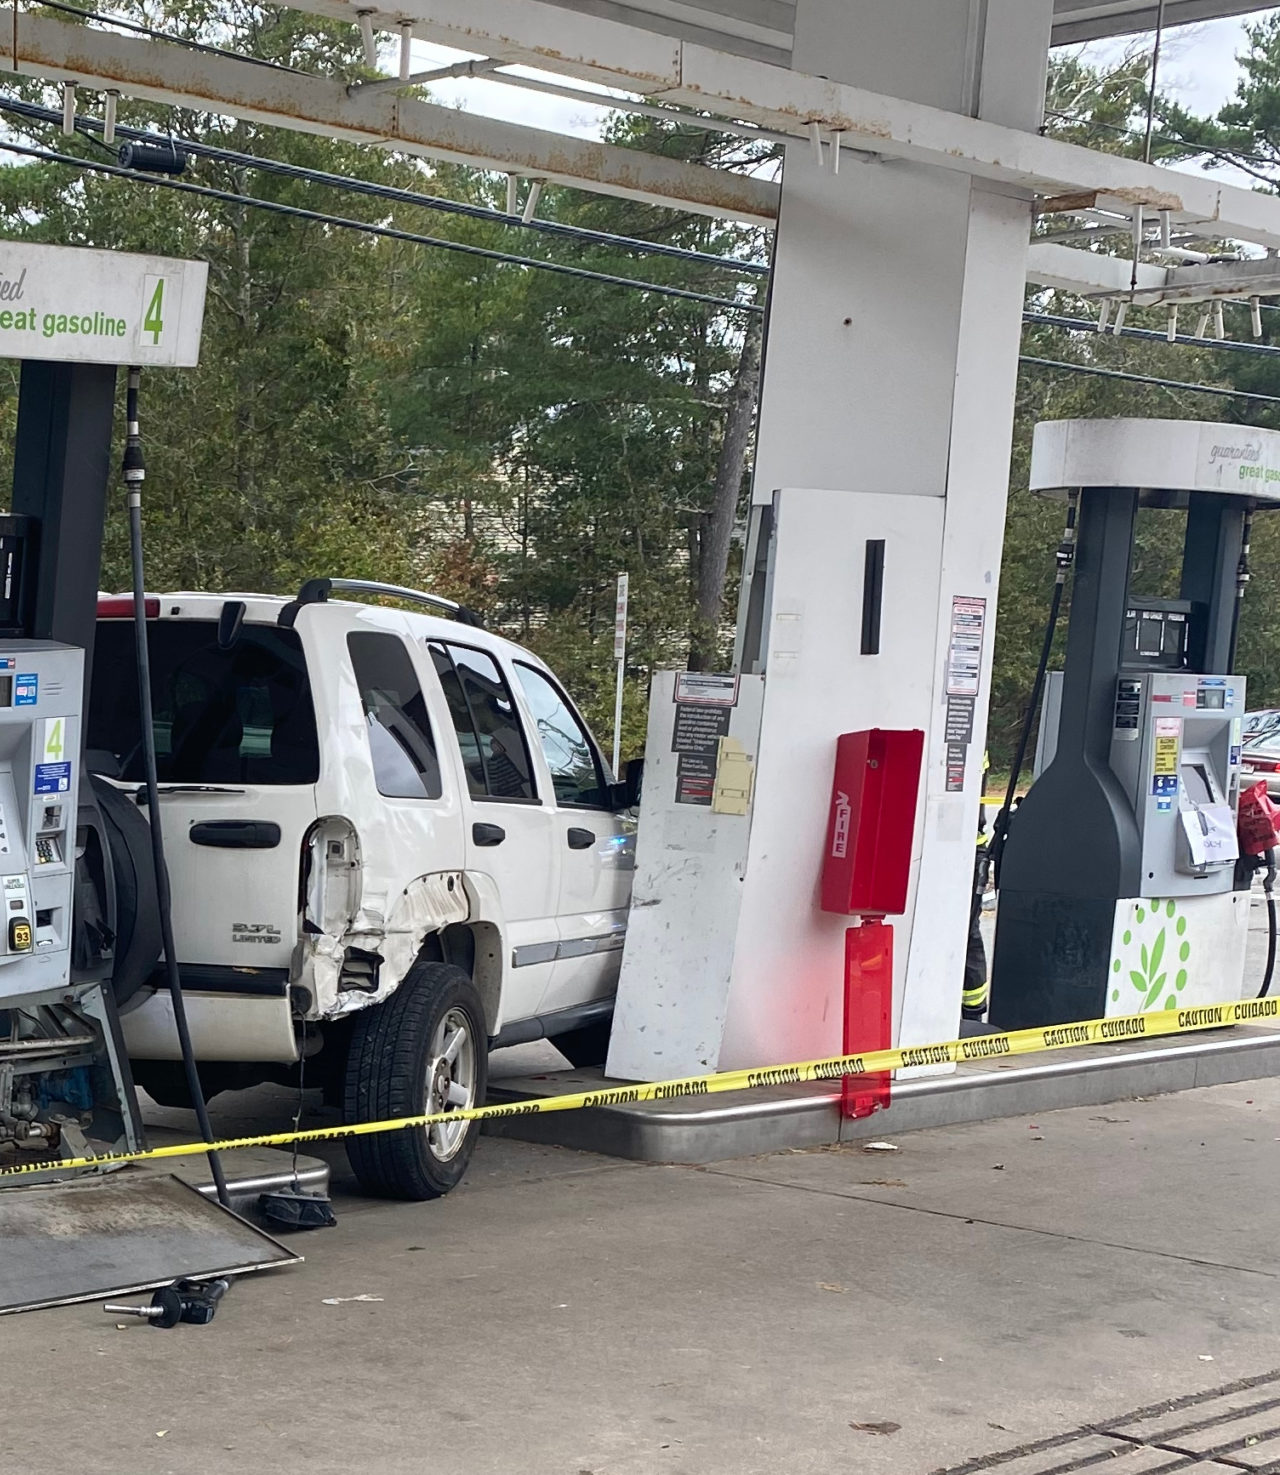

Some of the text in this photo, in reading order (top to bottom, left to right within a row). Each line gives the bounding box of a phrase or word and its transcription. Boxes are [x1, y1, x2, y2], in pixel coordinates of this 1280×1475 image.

[42, 311, 127, 338] gasoline
[143, 278, 164, 345] 4
[46, 720, 62, 760] 4
[835, 808, 848, 853] FIRE
[16, 932, 29, 942] 93
[232, 934, 281, 944] LIMITED
[1178, 1007, 1222, 1027] CAUTION
[1234, 1000, 1278, 1020] CUIDADO
[1042, 1025, 1090, 1047] CAUTION
[1100, 1017, 1145, 1038] CUIDADO
[901, 1045, 951, 1067] CAUTION
[962, 1037, 1010, 1058] CUIDADO
[747, 1067, 800, 1088] CAUTION
[814, 1058, 865, 1080] CUIDADO
[583, 1089, 639, 1107] CAUTION
